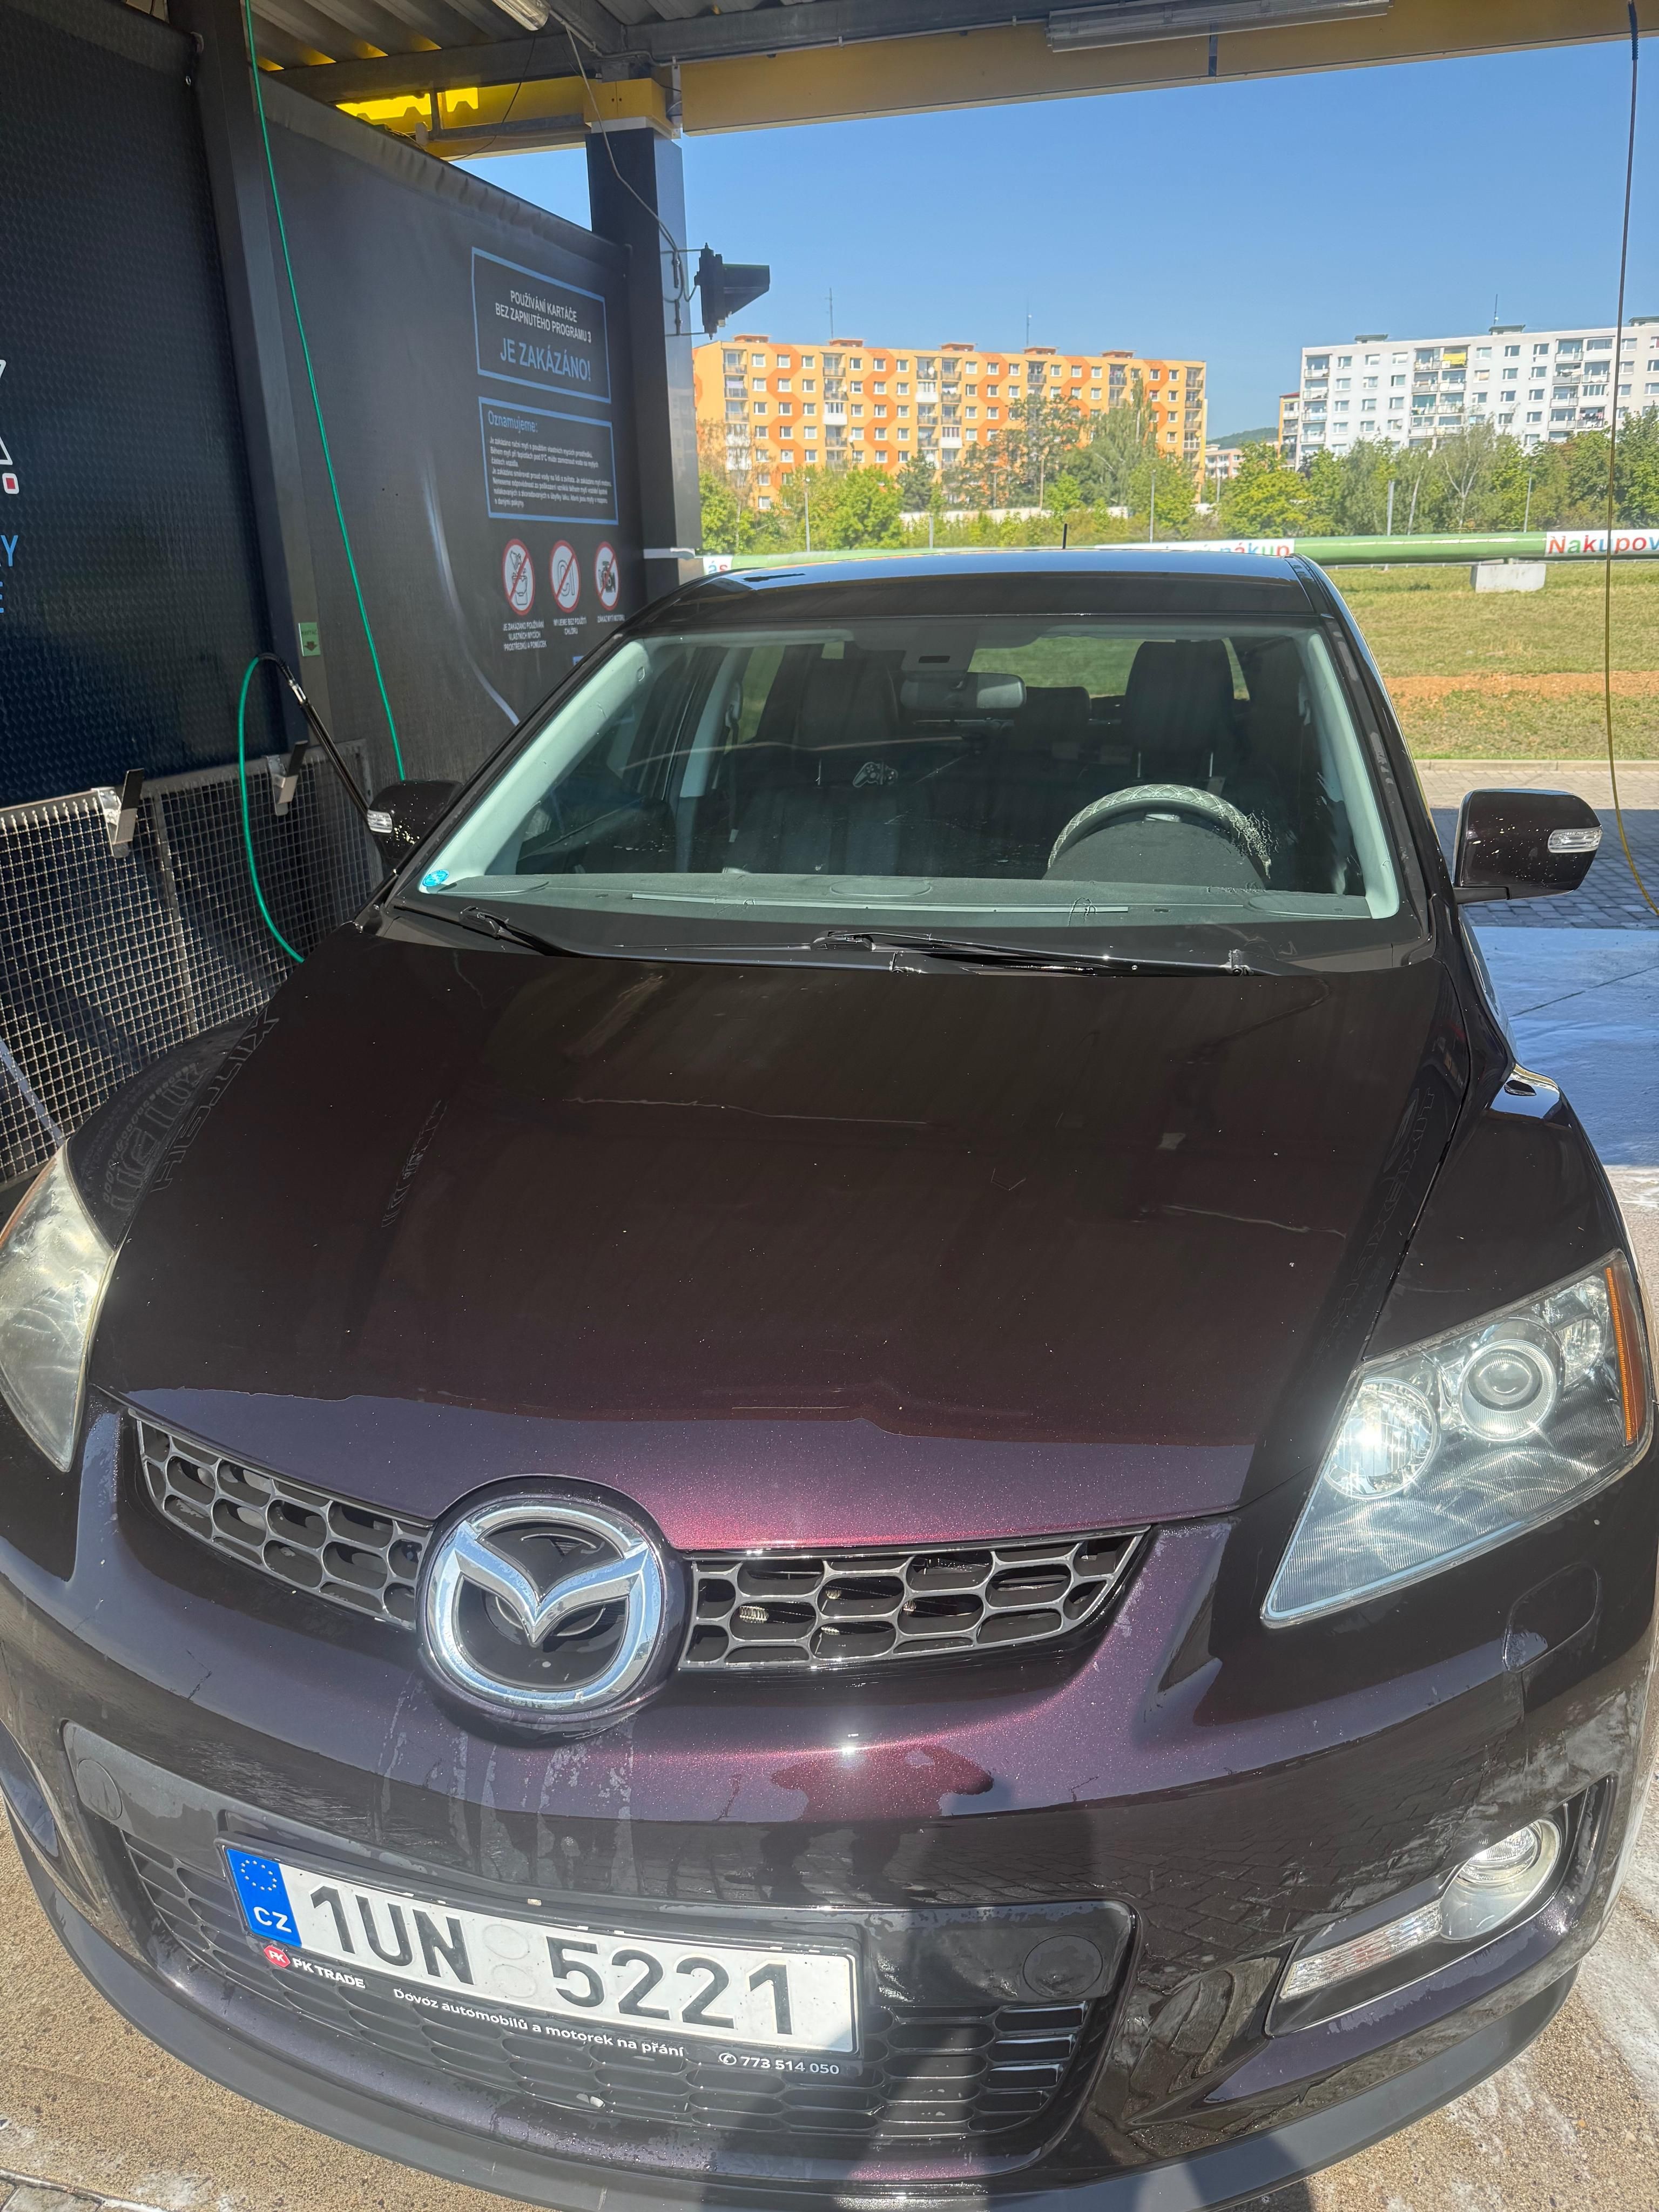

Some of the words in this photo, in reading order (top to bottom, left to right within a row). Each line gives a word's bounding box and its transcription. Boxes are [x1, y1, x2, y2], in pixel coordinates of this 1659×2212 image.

[510, 290, 546, 313] POUŽÍVÁNÍ
[547, 302, 577, 323] KARTÁČE
[495, 302, 509, 319] BEZ
[510, 307, 551, 332] ZAPNUTÉHO
[551, 321, 587, 341] PROGRAMU
[588, 331, 591, 343] 3
[500, 338, 516, 363] JE
[519, 341, 591, 381] ZAKÁZÁNO!
[488, 410, 538, 433] Oznamujeme:
[253, 1906, 292, 1933] CZ
[268, 1950, 285, 1963] PK
[310, 1886, 475, 1986] 1UN
[546, 1936, 793, 2035] 5221
[292, 1958, 315, 1973] PK
[314, 1965, 366, 1988] TRADE
[393, 1988, 439, 2008] Dovoz
[442, 2002, 528, 2030] automobilů
[532, 2024, 542, 2033] a
[545, 2026, 613, 2046] motorek
[617, 2038, 637, 2049] na
[642, 2042, 684, 2056] přání
[740, 2056, 771, 2069] 773
[775, 2060, 806, 2072] 514
[810, 2063, 839, 2074] 050
